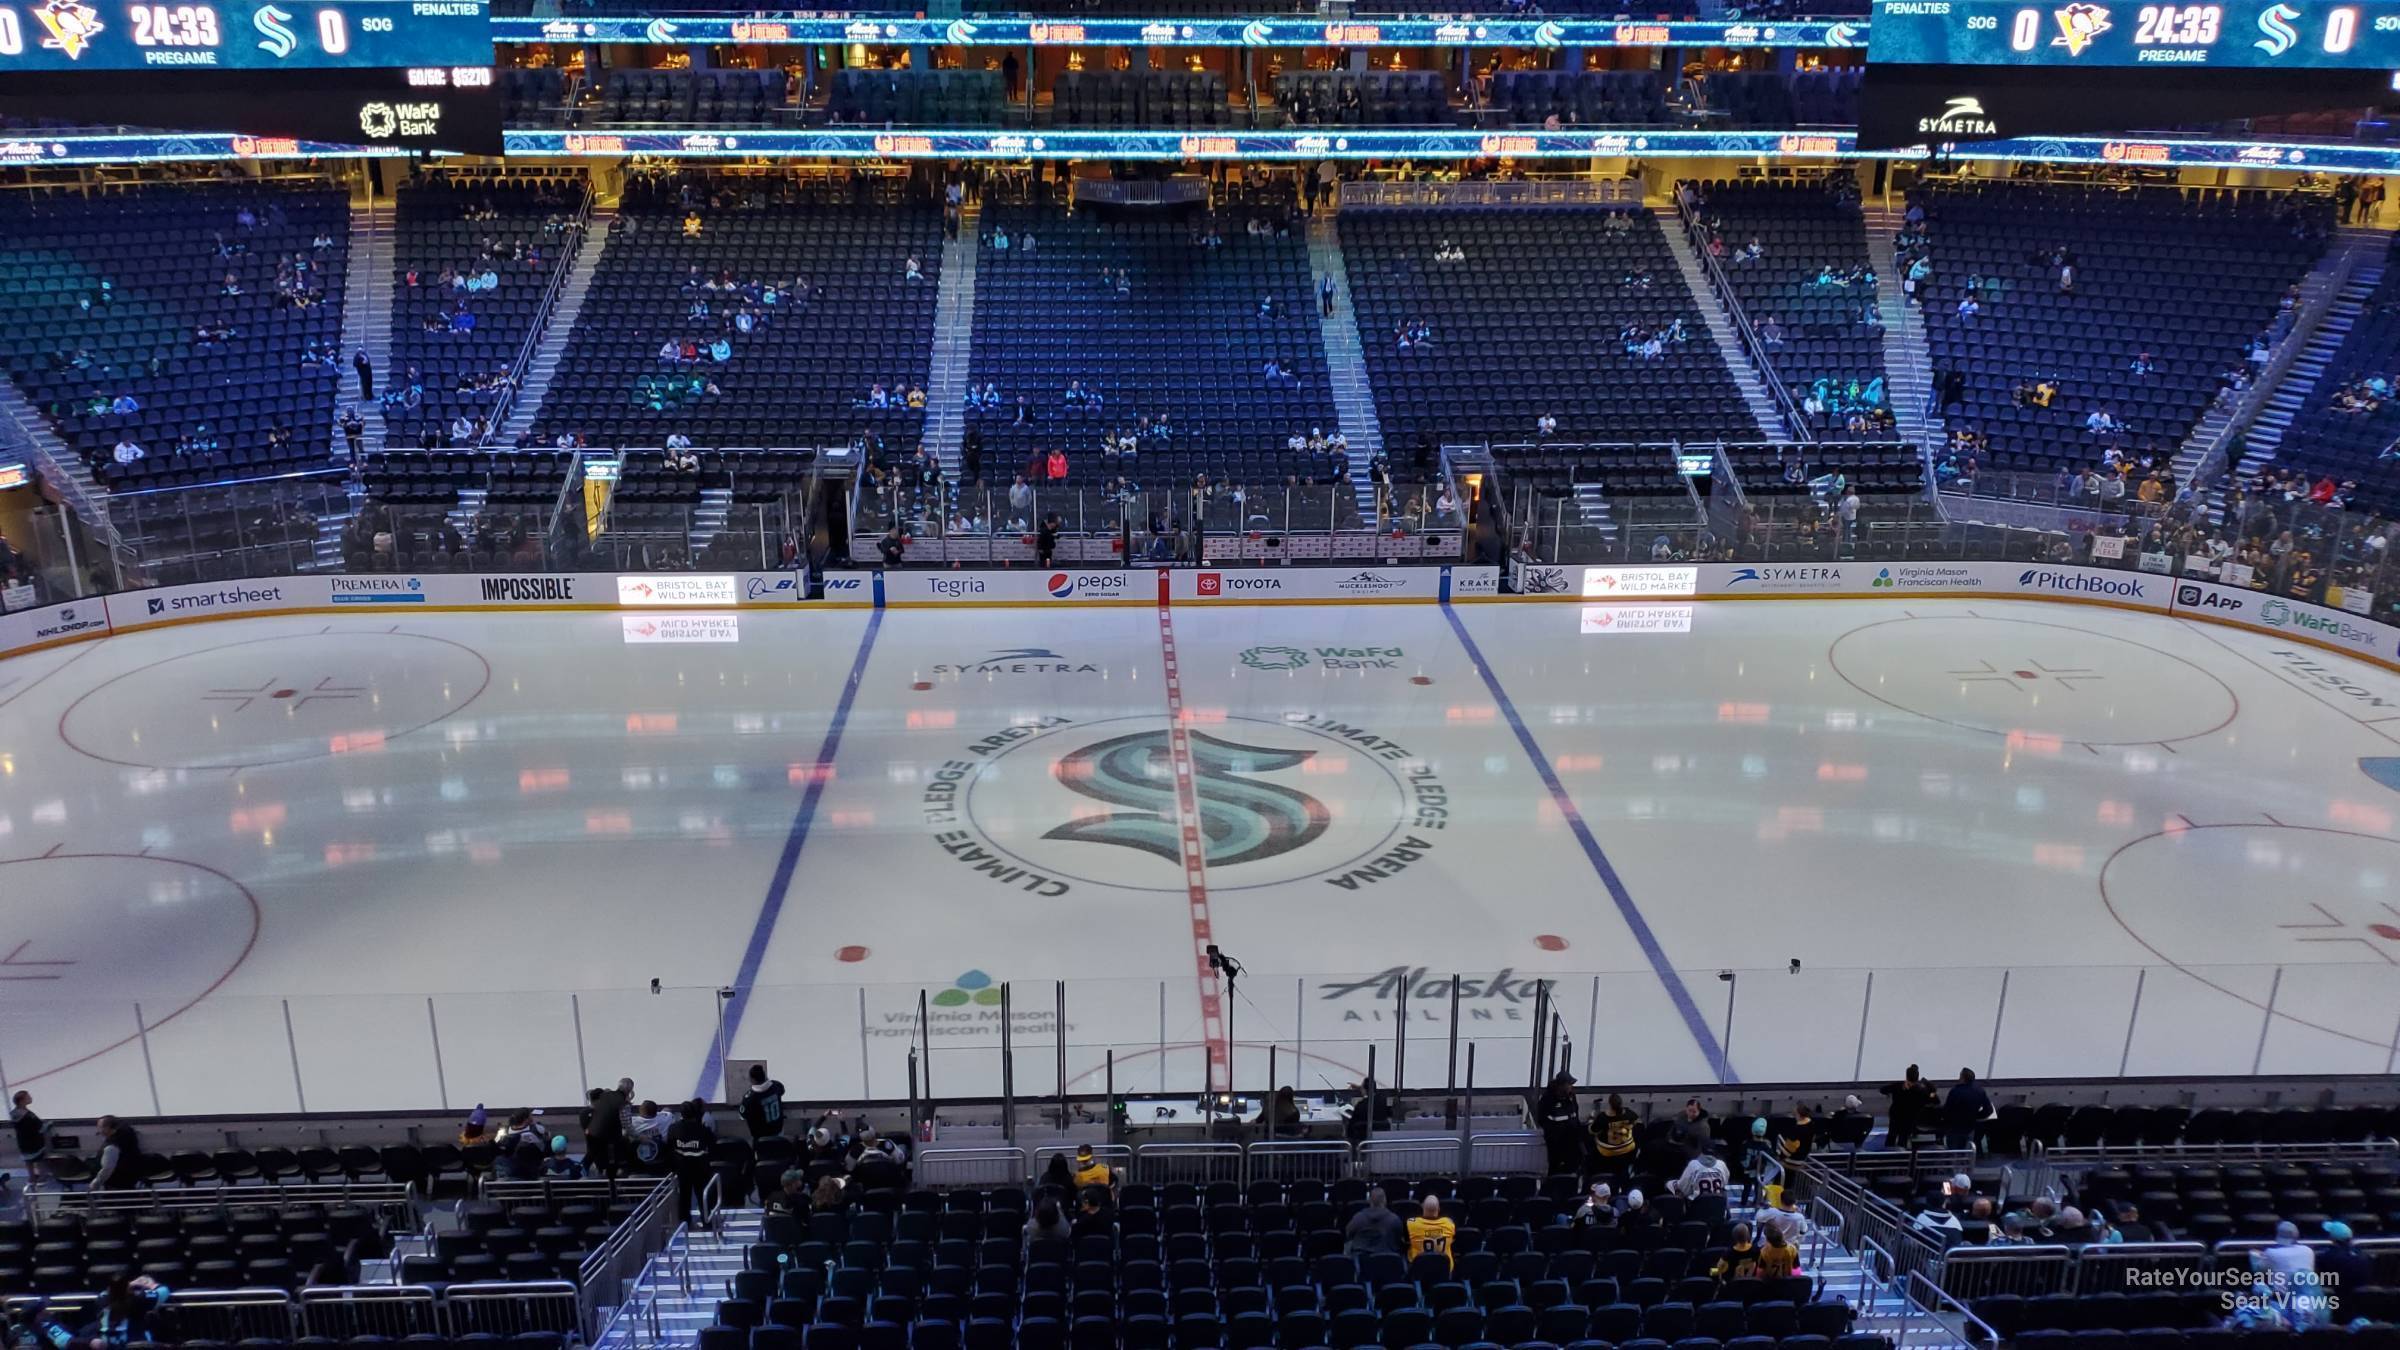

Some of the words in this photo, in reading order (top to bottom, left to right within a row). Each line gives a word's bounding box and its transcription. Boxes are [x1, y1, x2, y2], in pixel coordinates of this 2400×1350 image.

[413, 4, 479, 16] PENALTIES
[1885, 3, 1950, 15] PENALTIES
[130, 6, 220, 46] 24:33
[362, 18, 393, 32] SOG
[1967, 17, 1998, 29] SOG
[2013, 9, 2040, 51] 0
[2134, 6, 2221, 44] 24:33
[2374, 16, 2400, 31] SO
[319, 9, 346, 54] 0
[2323, 8, 2356, 53] 0
[146, 51, 217, 65] PREGAME
[2138, 50, 2207, 62] PREGAME
[396, 104, 440, 119] WaFd
[400, 120, 437, 135] Bank
[1919, 118, 1997, 134] SYMETRA
[1621, 573, 1665, 582] BRISTOL
[1668, 573, 1690, 581] BAY
[1762, 568, 1841, 580] SYMETRA
[1899, 568, 1935, 578] Virginia
[1937, 567, 1968, 576] Mason
[331, 578, 400, 592] PREMERA
[481, 577, 573, 600] IMPOSSIBLE
[657, 581, 701, 590] BRISTOL
[705, 581, 728, 589] BAY
[776, 580, 861, 590] BING
[928, 577, 985, 597] Tegria
[1078, 573, 1127, 590] pepsi
[1226, 579, 1281, 590] TOYOTA
[1620, 582, 1648, 591] WILD
[1650, 582, 1696, 590] MARKET
[1898, 577, 1948, 586] Franciscan
[1950, 577, 1982, 587] Health
[2037, 571, 2145, 598] PitchBook
[172, 587, 281, 610] smartsheet
[657, 591, 687, 599] WILD
[689, 591, 735, 599] MARKET
[2293, 611, 2340, 634] WaFd
[2340, 623, 2378, 647] Bank
[1316, 645, 1404, 658] WaFd
[933, 663, 1097, 673] SYMETRA
[1324, 657, 1398, 670] Bank
[2269, 650, 2399, 707] FILSON
[934, 830, 1070, 897] CLIMATE
[1324, 835, 1434, 890] ARENA
[1319, 965, 1560, 1003] Alaska
[980, 1010, 1055, 1021] Mson
[1344, 1008, 1523, 1022] AILNE
